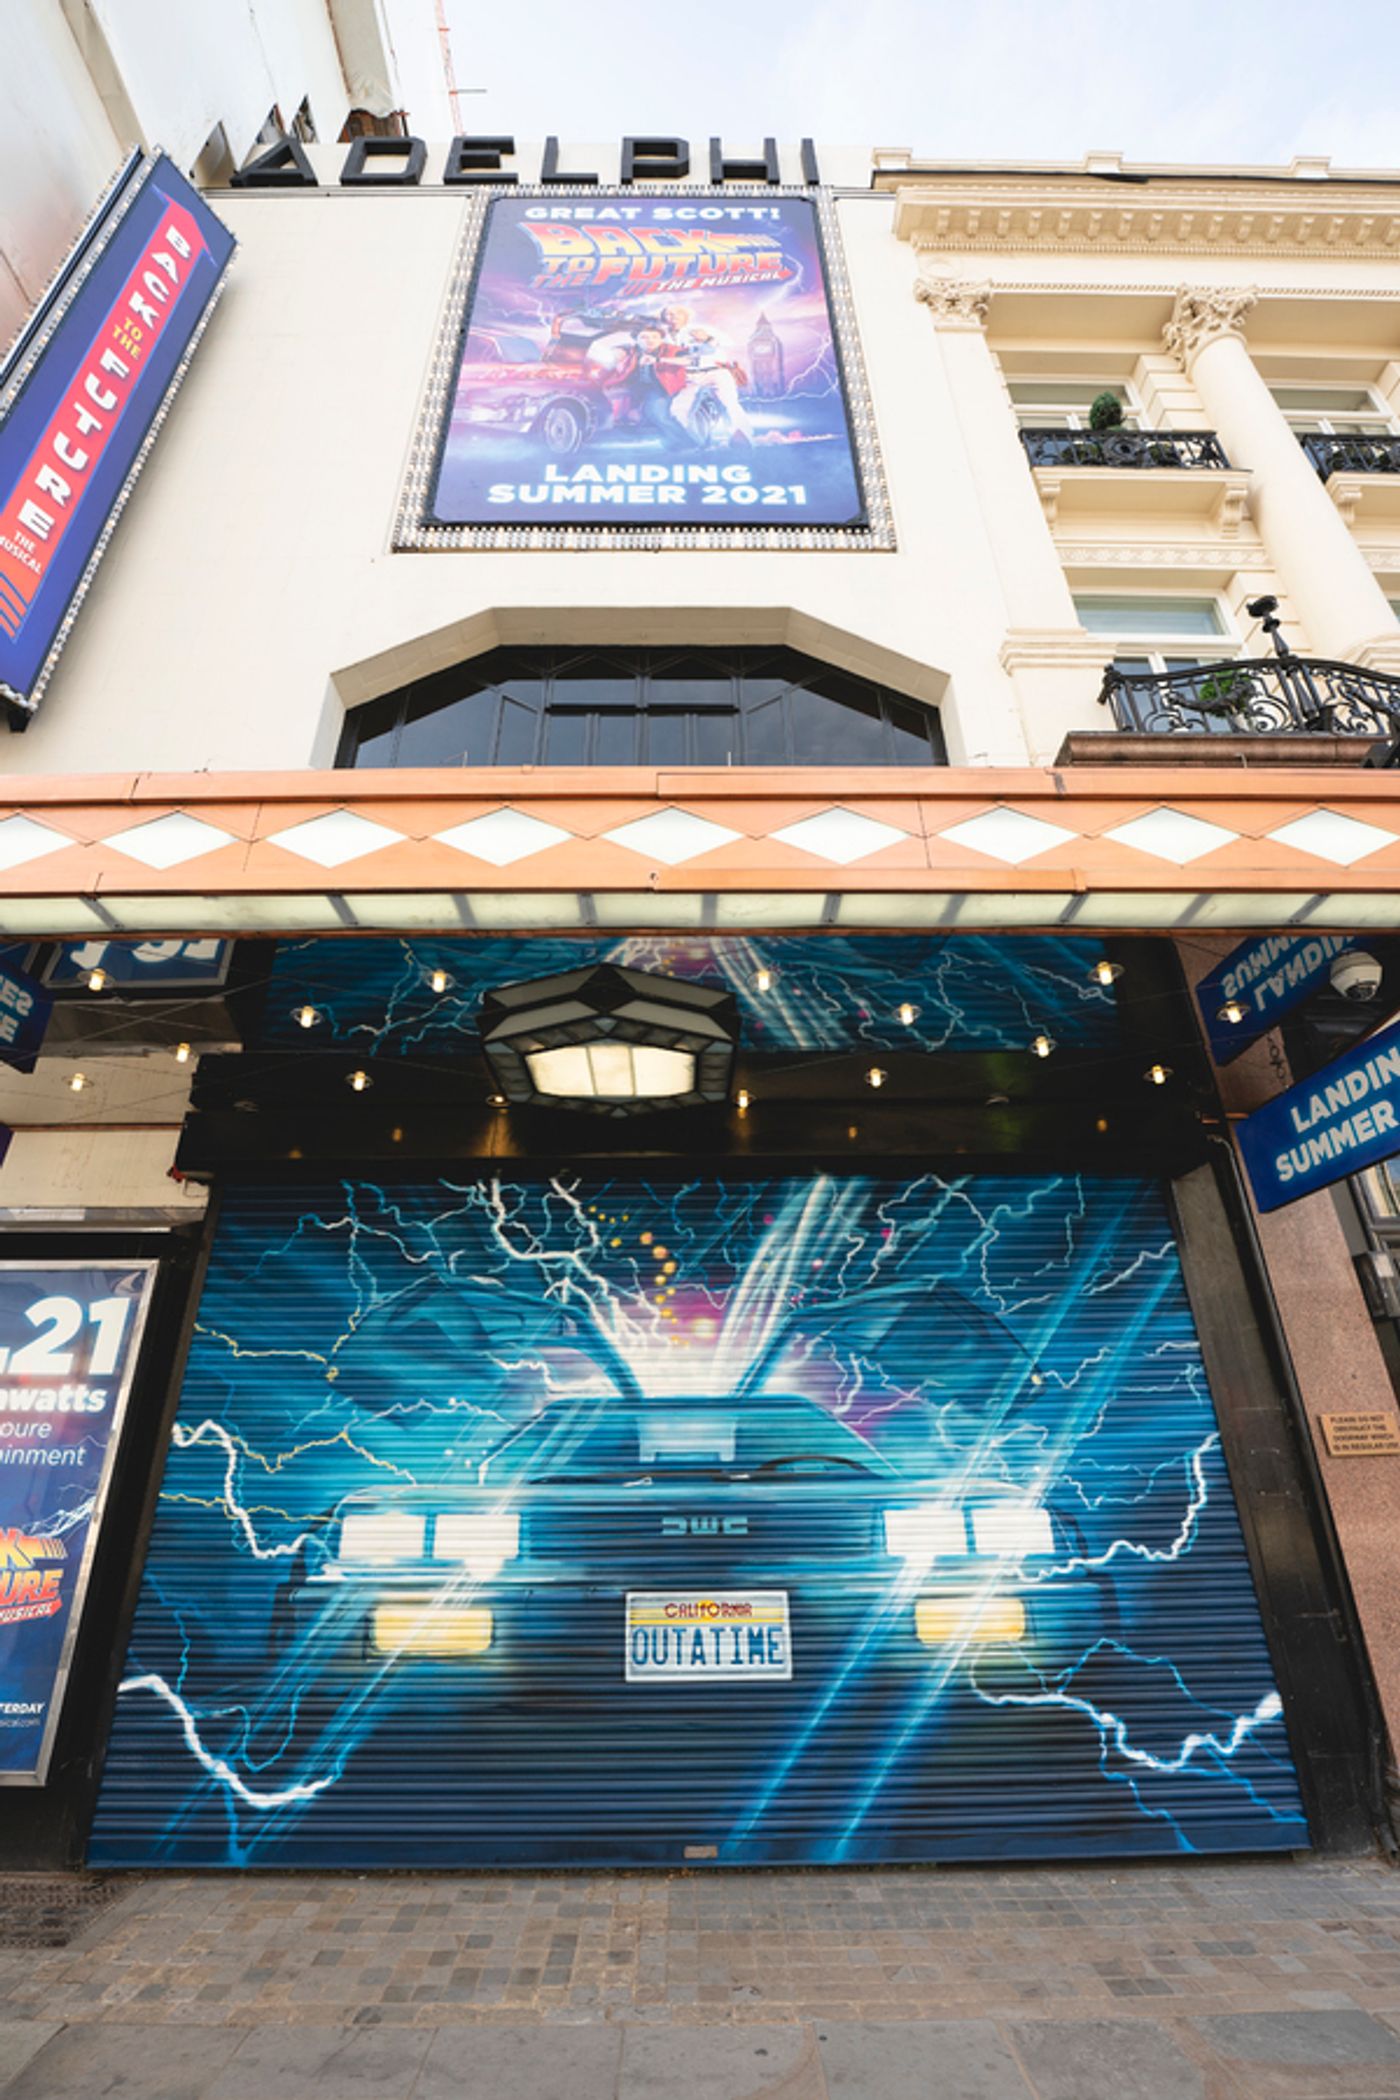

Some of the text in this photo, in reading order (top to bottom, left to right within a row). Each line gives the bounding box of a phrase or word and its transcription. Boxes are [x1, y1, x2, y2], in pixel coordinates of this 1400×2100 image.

[229, 136, 820, 188] ADELPHI
[525, 207, 781, 221] GREAT SCOTT!
[518, 222, 781, 256] BACK
[128, 223, 192, 331] BACK
[543, 251, 784, 285] TO FUTURE
[656, 270, 783, 292] THE MUSICAL
[112, 324, 142, 361] THE
[123, 317, 144, 341] TO
[17, 347, 131, 541] FUTURE
[543, 464, 752, 483] LANDING
[487, 484, 807, 504] SUMMER 2021
[14, 530, 36, 554] THE
[1275, 1099, 1400, 1182] SUMMER
[0, 1384, 108, 1413] watts
[631, 1626, 784, 1666] OUTATIME
